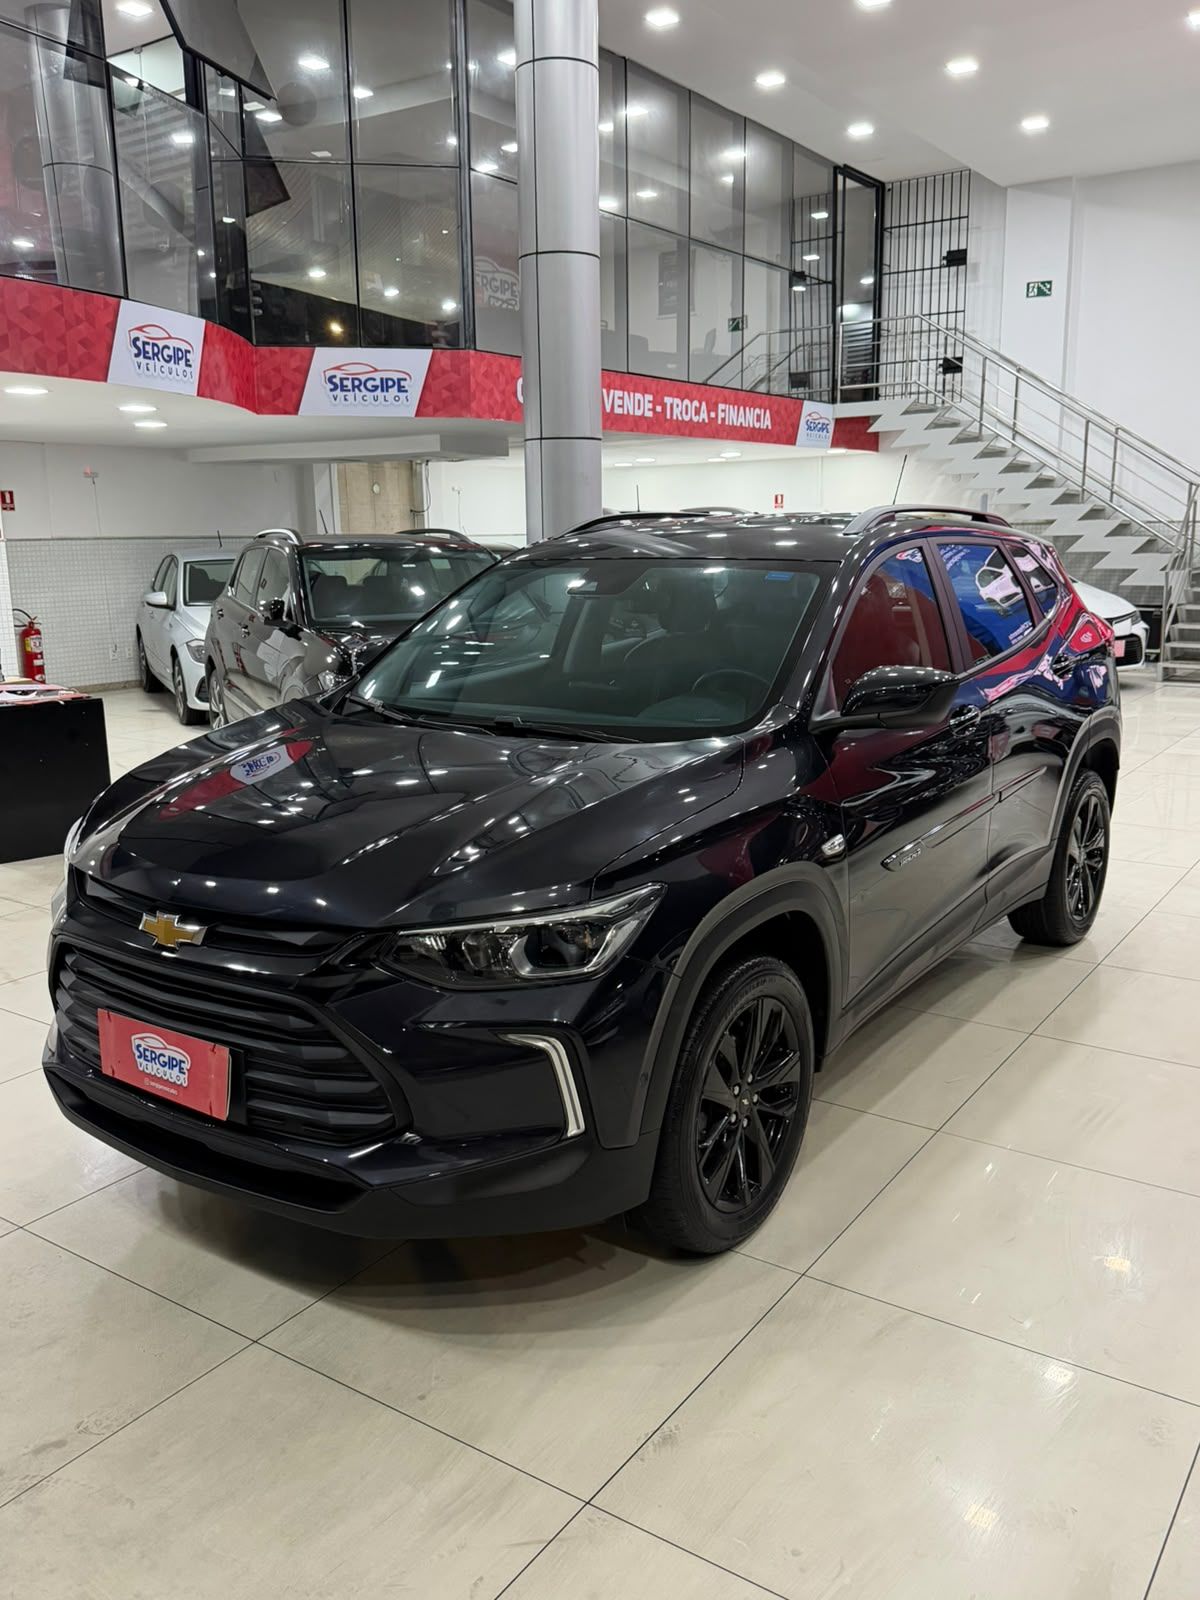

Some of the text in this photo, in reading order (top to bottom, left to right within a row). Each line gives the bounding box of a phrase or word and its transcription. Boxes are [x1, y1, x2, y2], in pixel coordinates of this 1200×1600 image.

[132, 336, 192, 367] SERGIPE
[136, 361, 193, 379] VEÍCULOS
[327, 374, 408, 393] SERGIPE
[333, 392, 409, 402] VEÍCULOS
[602, 388, 653, 417] VENDE
[664, 396, 708, 423] TROCA
[718, 403, 771, 429] FINANCIA
[136, 1044, 186, 1075] SERGIPE
